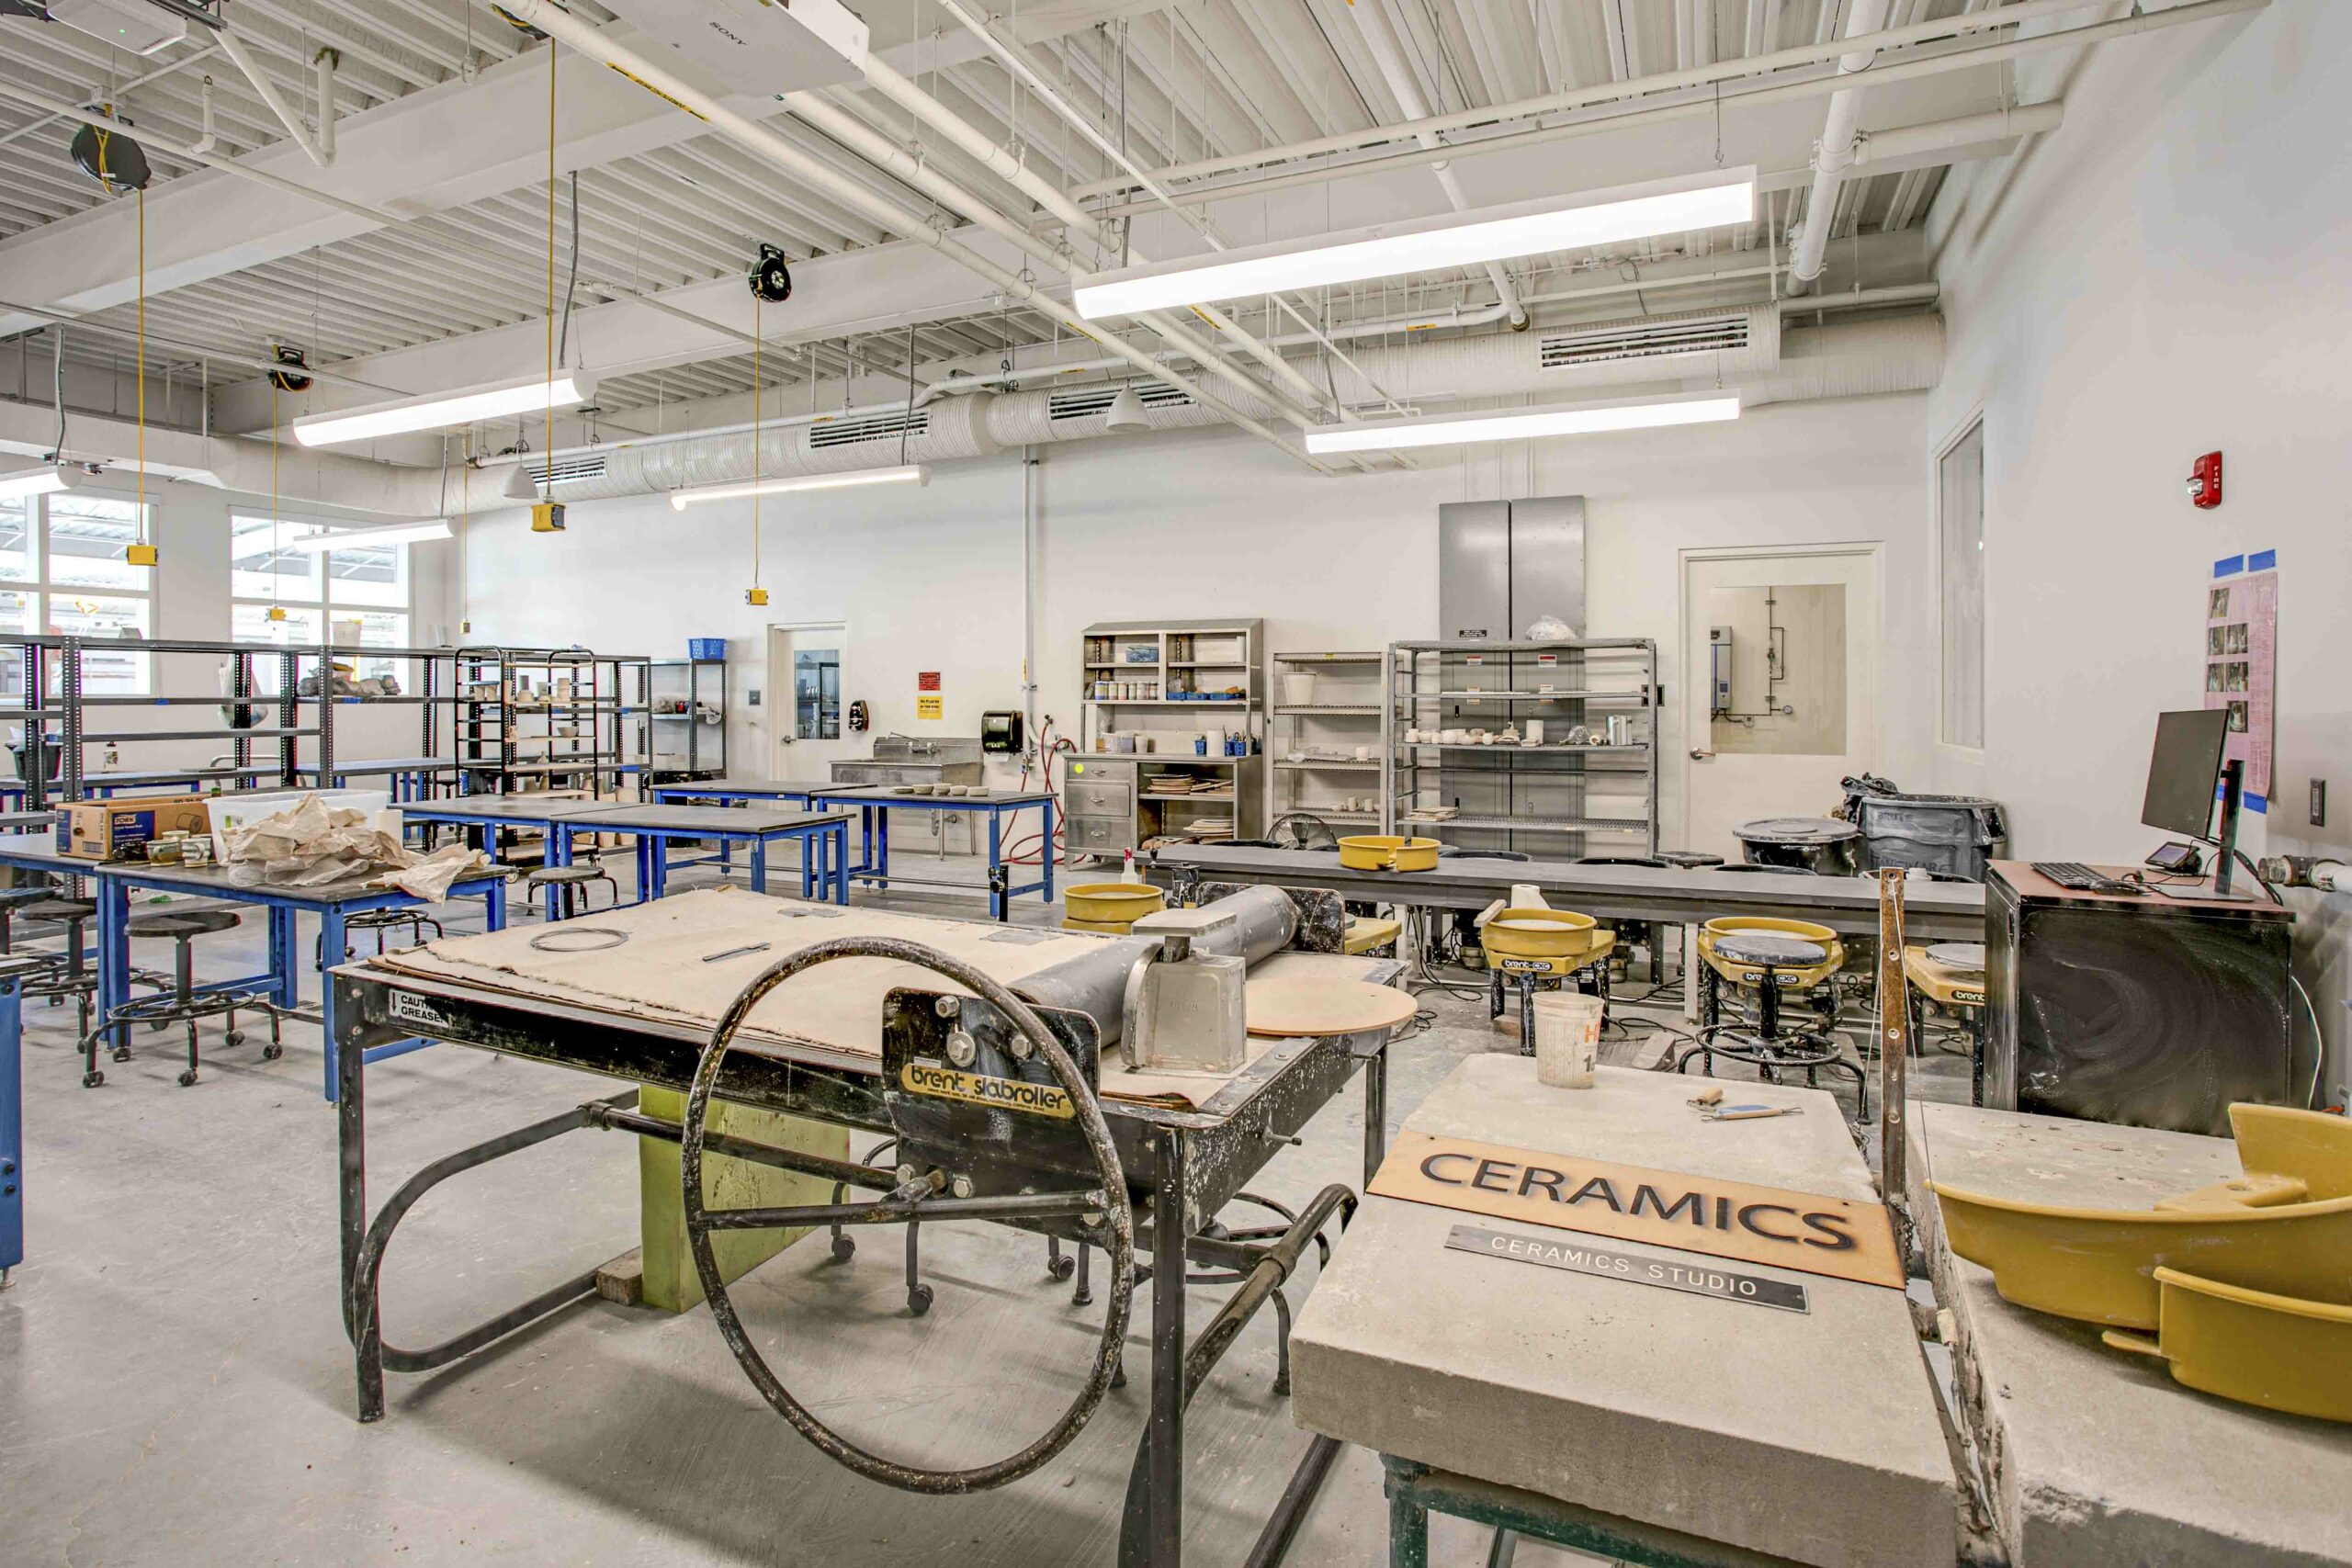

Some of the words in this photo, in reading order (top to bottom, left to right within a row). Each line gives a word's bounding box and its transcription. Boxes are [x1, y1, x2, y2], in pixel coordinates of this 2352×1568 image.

[709, 21, 748, 46] SONY
[911, 1065, 965, 1091] brent
[974, 1077, 1067, 1111] slabroller
[1420, 1153, 1853, 1250] CERAMICS
[1490, 1235, 1631, 1273] CERAMICS
[1647, 1264, 1757, 1296] STUDIO
